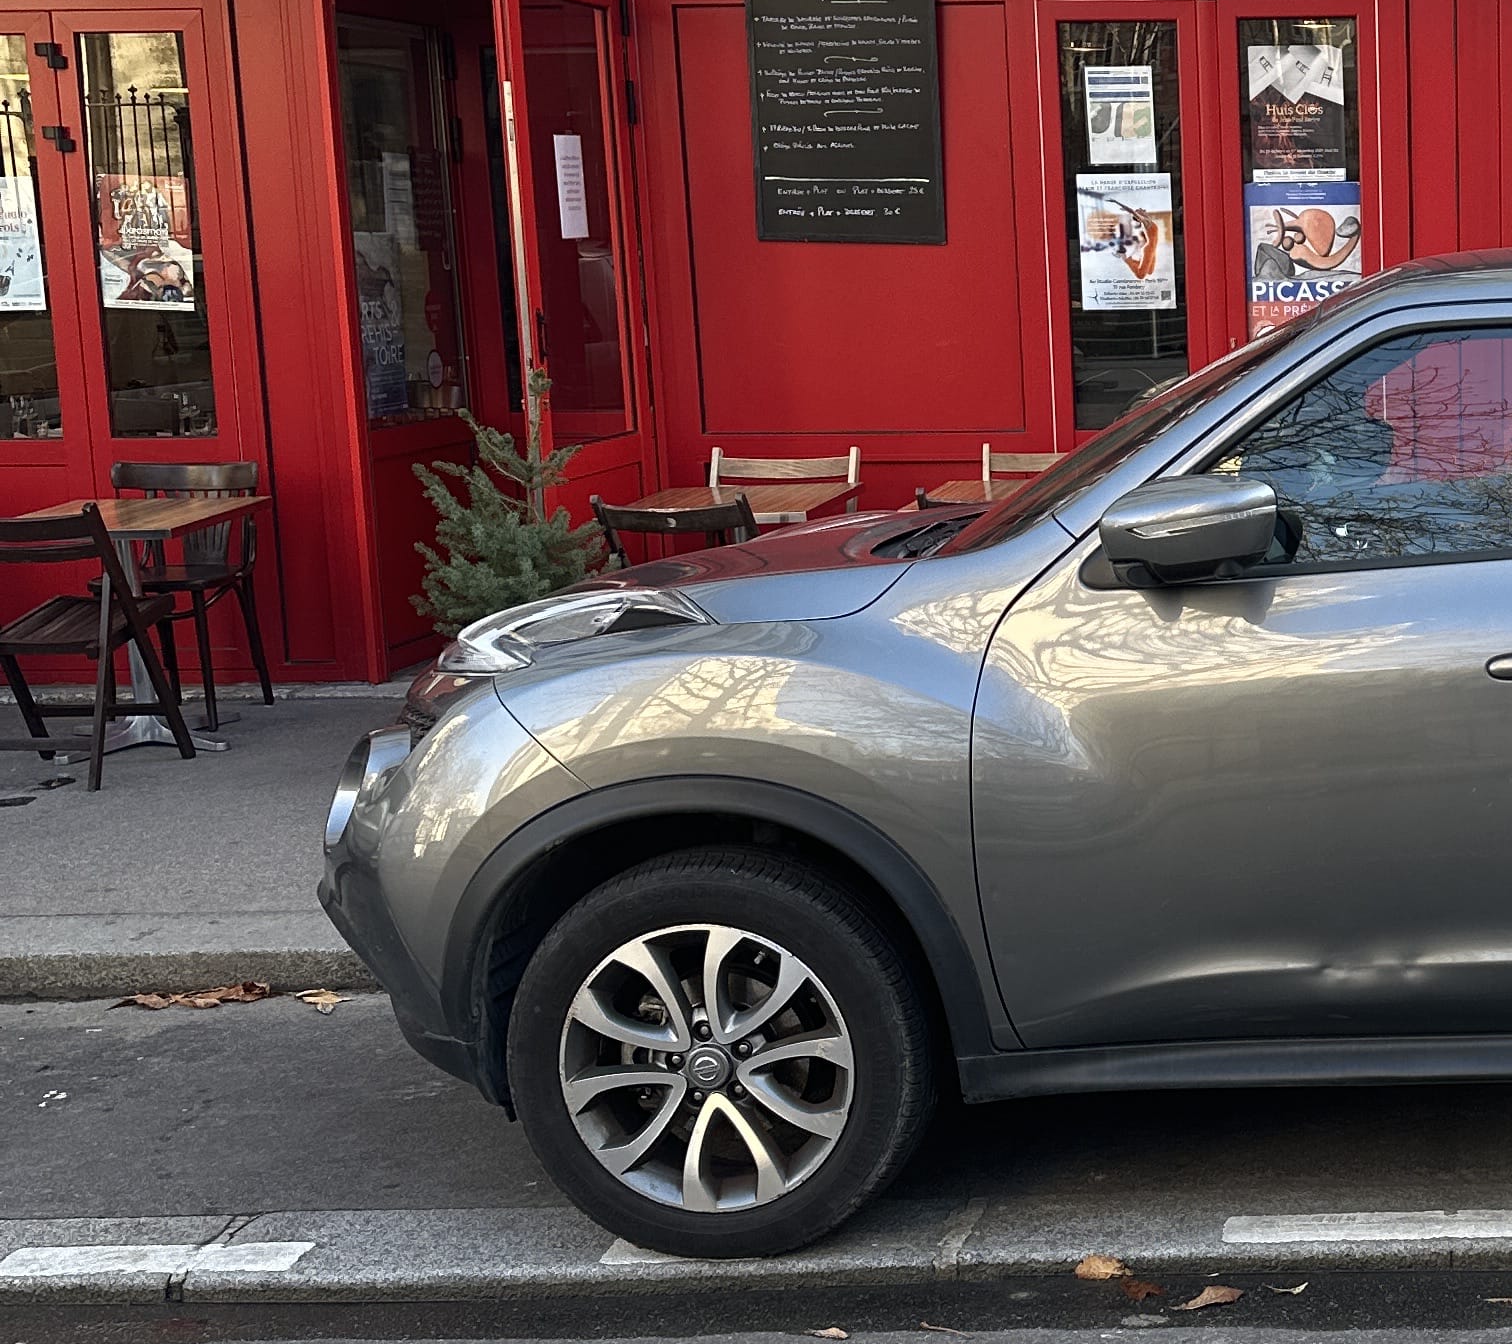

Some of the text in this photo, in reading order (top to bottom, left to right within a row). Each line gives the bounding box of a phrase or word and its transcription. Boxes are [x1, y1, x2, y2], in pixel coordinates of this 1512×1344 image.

[1265, 103, 1294, 116] Huis
[1252, 306, 1266, 316] ET
[1270, 306, 1280, 316] LA
